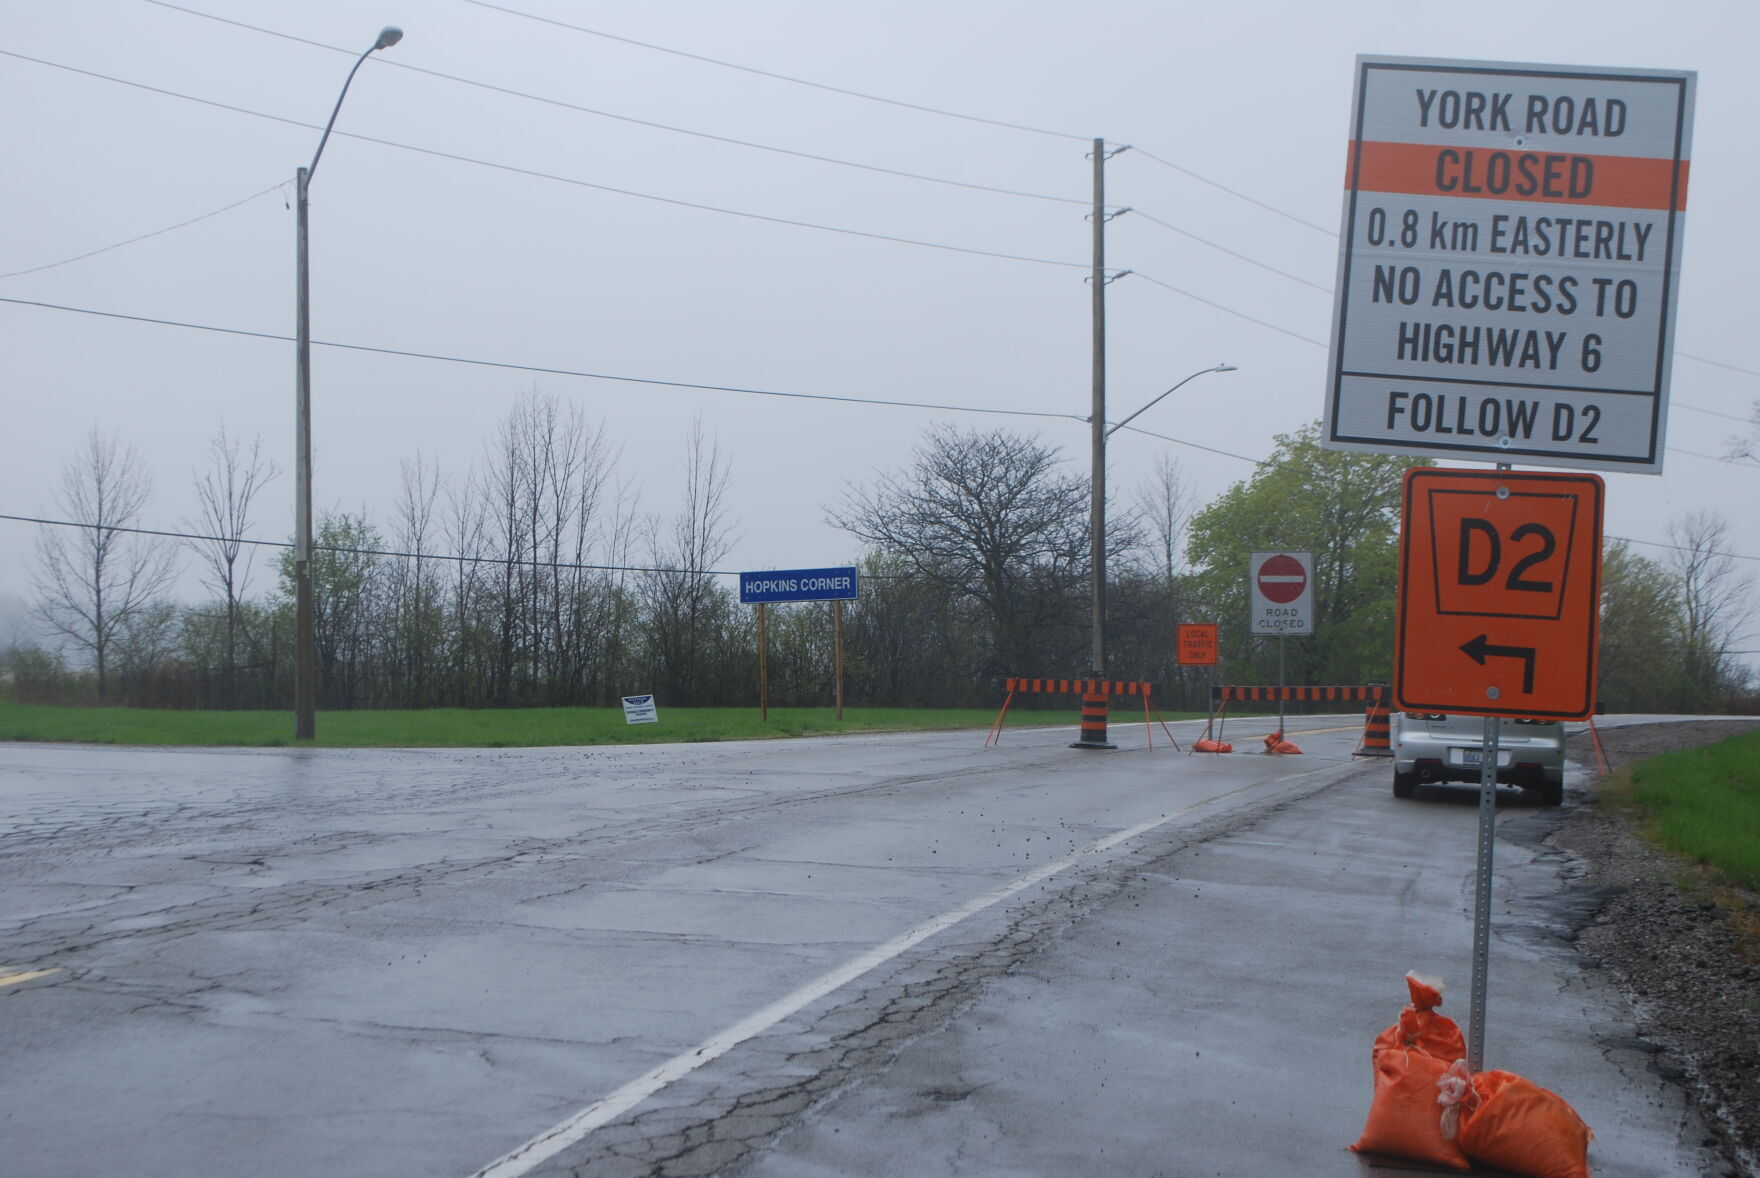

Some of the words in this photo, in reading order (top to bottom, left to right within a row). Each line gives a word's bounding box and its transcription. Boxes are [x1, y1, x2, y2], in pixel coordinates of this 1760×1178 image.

[1415, 88, 1513, 132] YORK
[1526, 95, 1627, 138] ROAD
[1435, 149, 1595, 200] CLOSED
[1367, 207, 1419, 249] 0.8
[1430, 211, 1478, 252] km
[1490, 214, 1654, 262] EASTERLY
[1371, 264, 1421, 306] NO
[1432, 269, 1579, 316] ACCESS
[1592, 277, 1638, 319] TO
[1396, 321, 1567, 371] HIGHWAY
[1580, 333, 1603, 373] 6
[1386, 390, 1540, 440] FOLLOW
[1552, 402, 1601, 444] D2
[1457, 517, 1557, 594] D2
[745, 579, 798, 593] HOPKINS
[800, 577, 851, 591] CORNER
[1186, 629, 1209, 638] LOCAL
[1258, 619, 1305, 629] CLOSED
[1265, 608, 1299, 617] ROAD
[1183, 639, 1213, 649] TRAFFIC
[1188, 650, 1207, 660] ONLY
